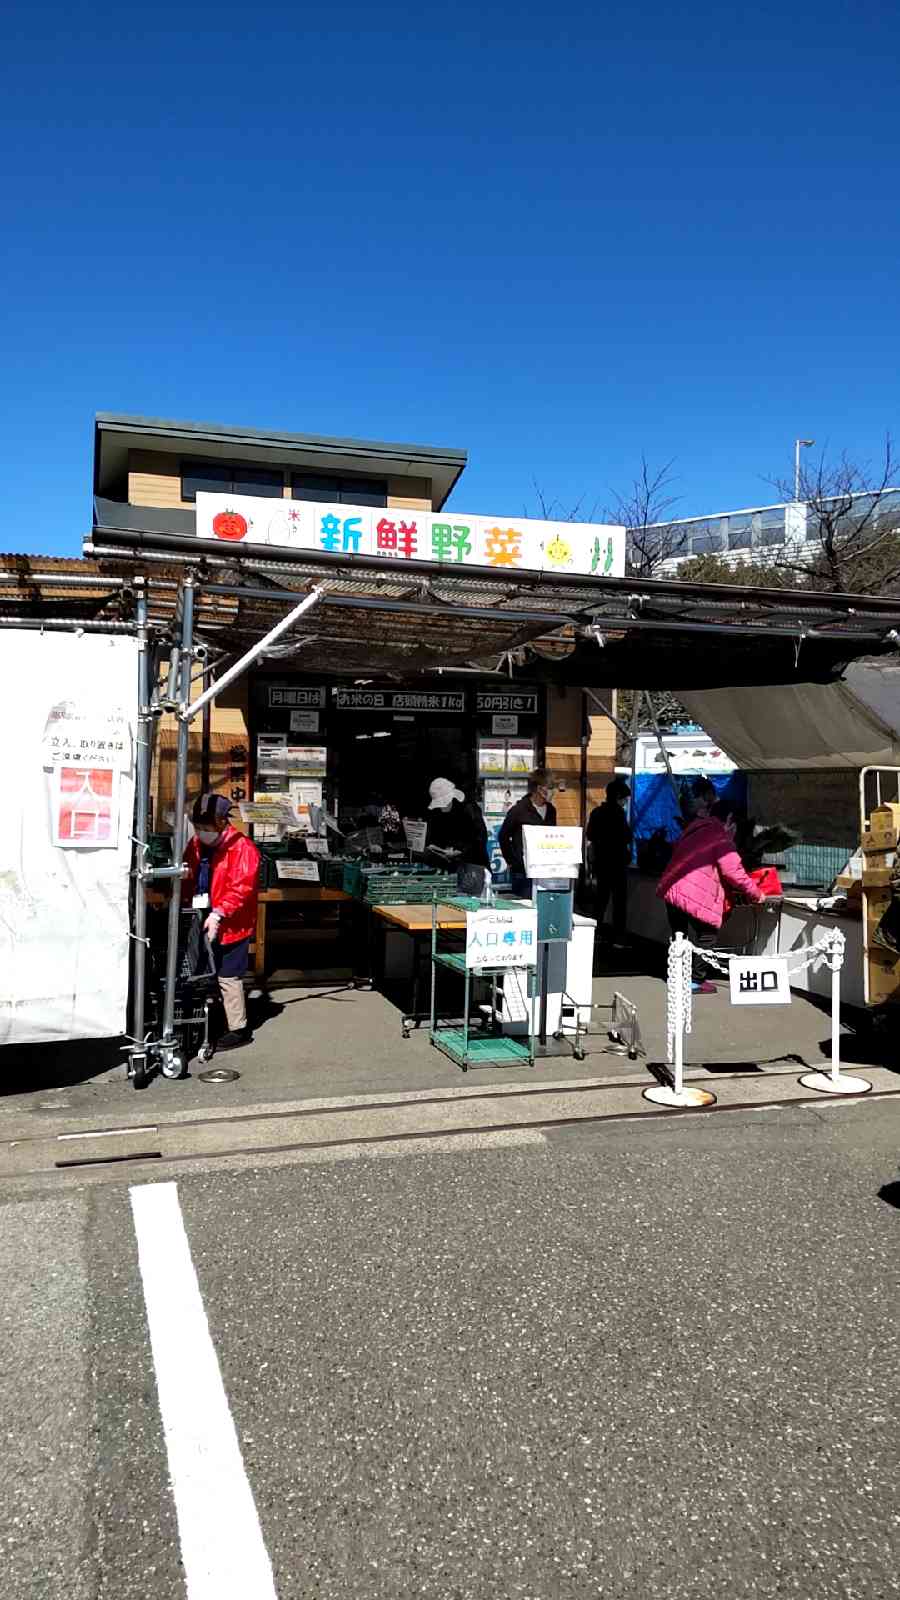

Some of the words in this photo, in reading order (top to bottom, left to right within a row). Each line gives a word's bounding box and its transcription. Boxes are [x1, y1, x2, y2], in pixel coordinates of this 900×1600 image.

[320, 512, 523, 566] 新鮮野菜
[60, 771, 113, 838] 入口
[740, 971, 778, 992] 出口
